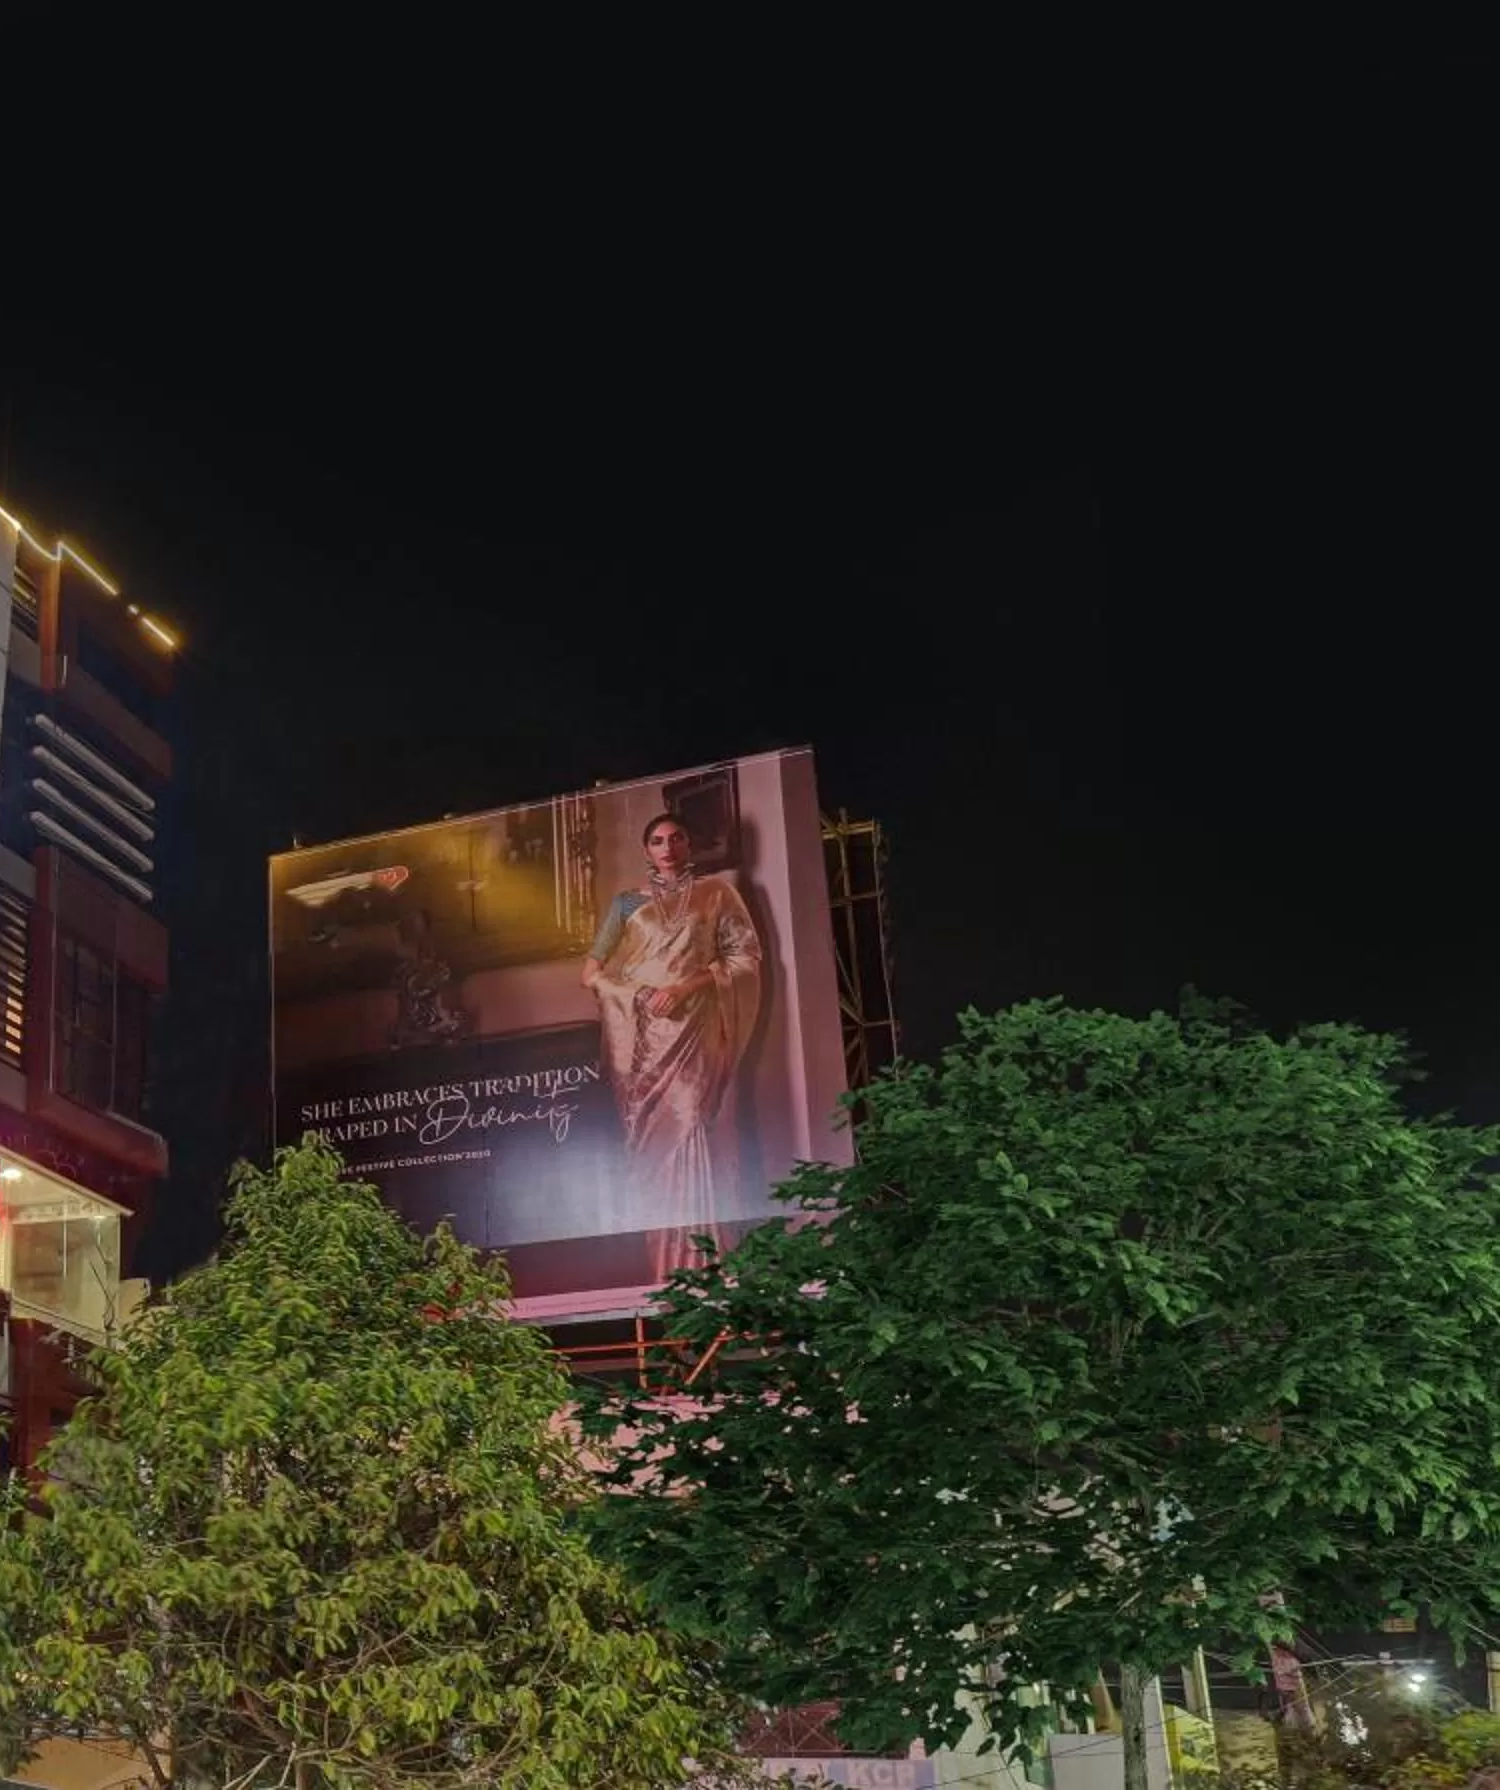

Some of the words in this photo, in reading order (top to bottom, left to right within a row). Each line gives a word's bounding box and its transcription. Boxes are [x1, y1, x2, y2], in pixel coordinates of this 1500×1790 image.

[300, 1100, 344, 1123] SHE
[349, 1081, 465, 1116] EMBRACES
[468, 1063, 600, 1098] TRADITION
[393, 1113, 418, 1135] IN
